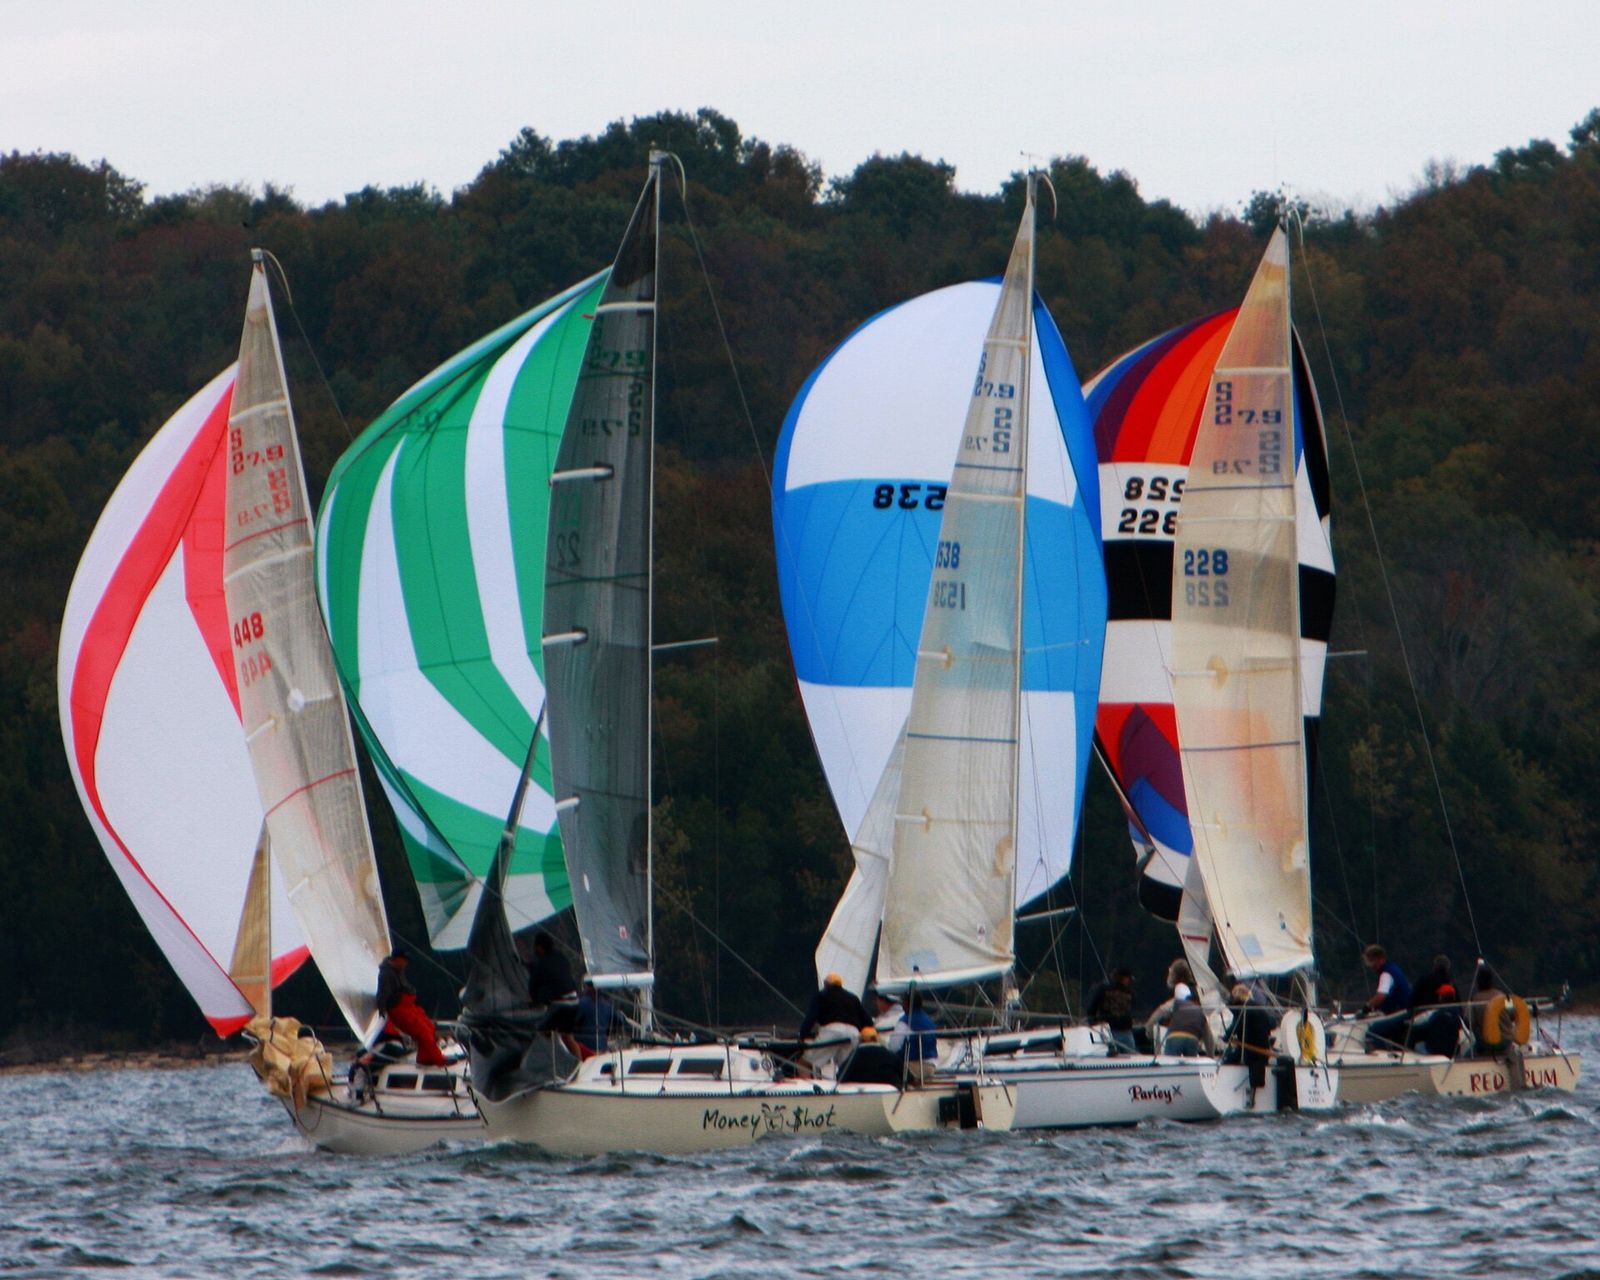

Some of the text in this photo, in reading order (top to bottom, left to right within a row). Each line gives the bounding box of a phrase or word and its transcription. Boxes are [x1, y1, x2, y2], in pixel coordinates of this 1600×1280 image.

[1184, 549, 1229, 576] 228
[233, 612, 264, 648] 448
[1128, 1084, 1172, 1105] Parley
[1470, 1072, 1505, 1093] RED
[703, 1104, 836, 1138] Money $hot
